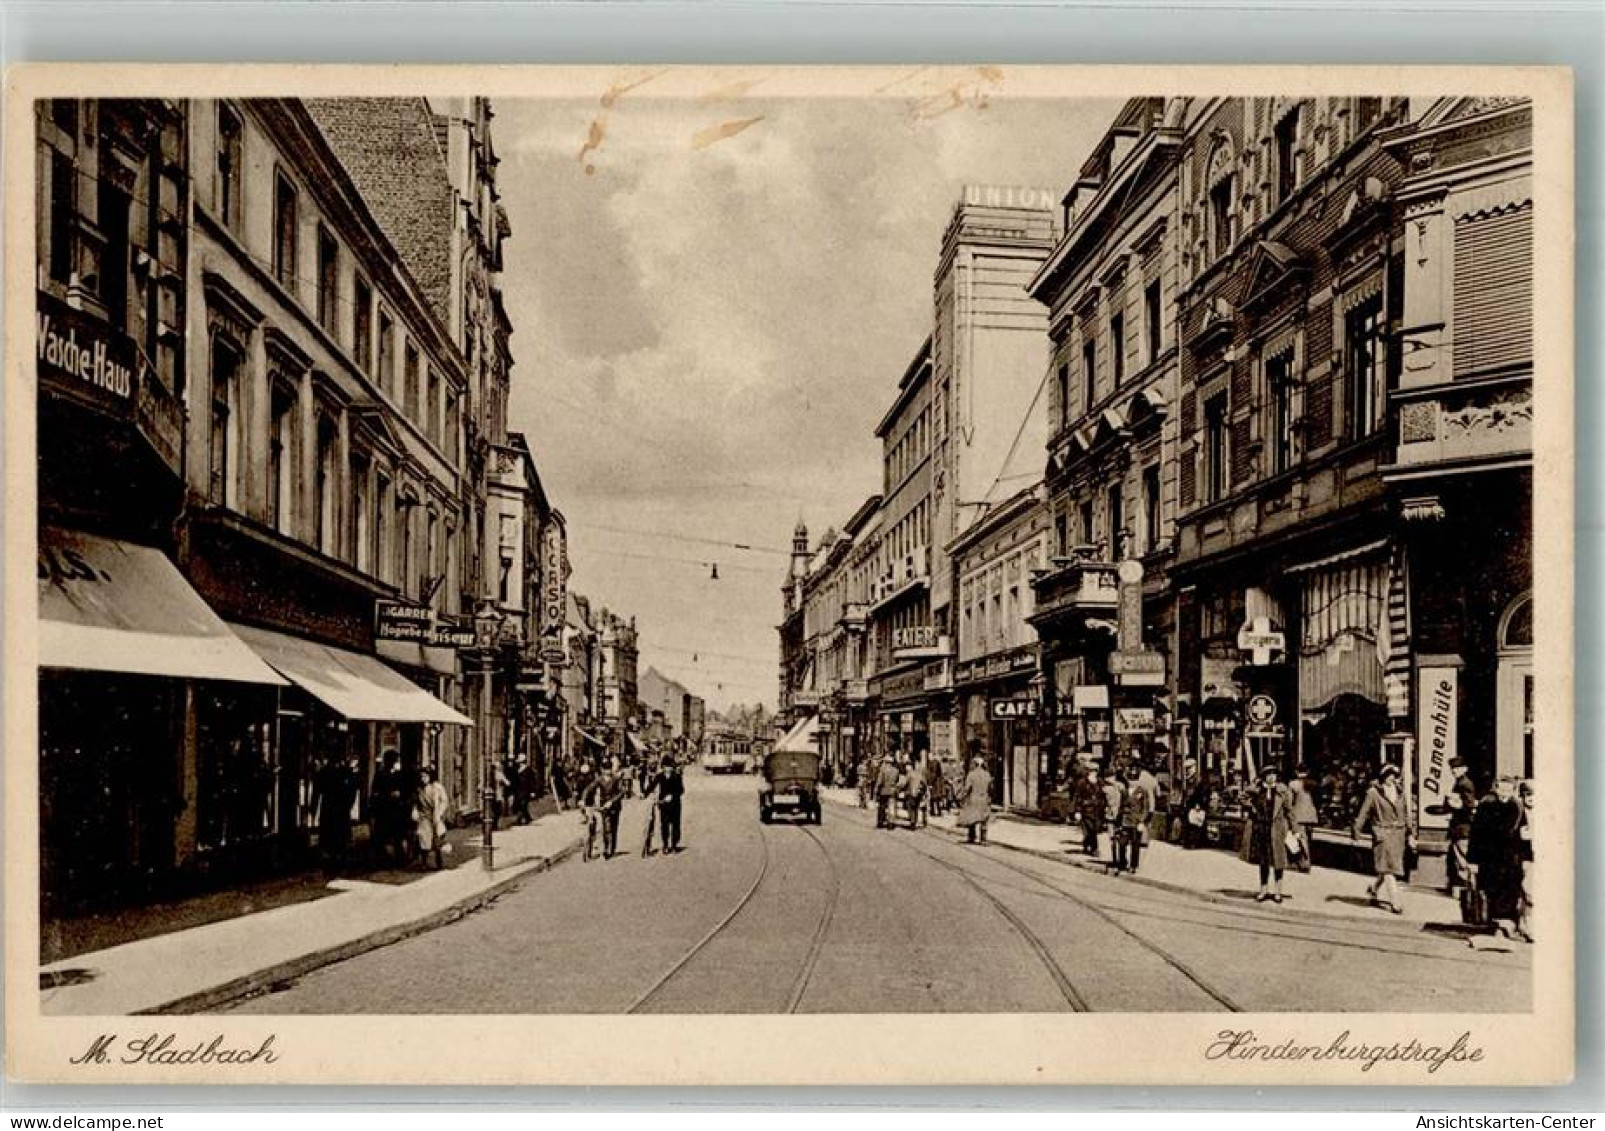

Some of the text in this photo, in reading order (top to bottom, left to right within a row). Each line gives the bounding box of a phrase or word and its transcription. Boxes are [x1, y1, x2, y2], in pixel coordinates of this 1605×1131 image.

[966, 184, 1055, 211] UNION
[994, 700, 1037, 716] CAFÉ
[70, 1034, 114, 1065] M.
